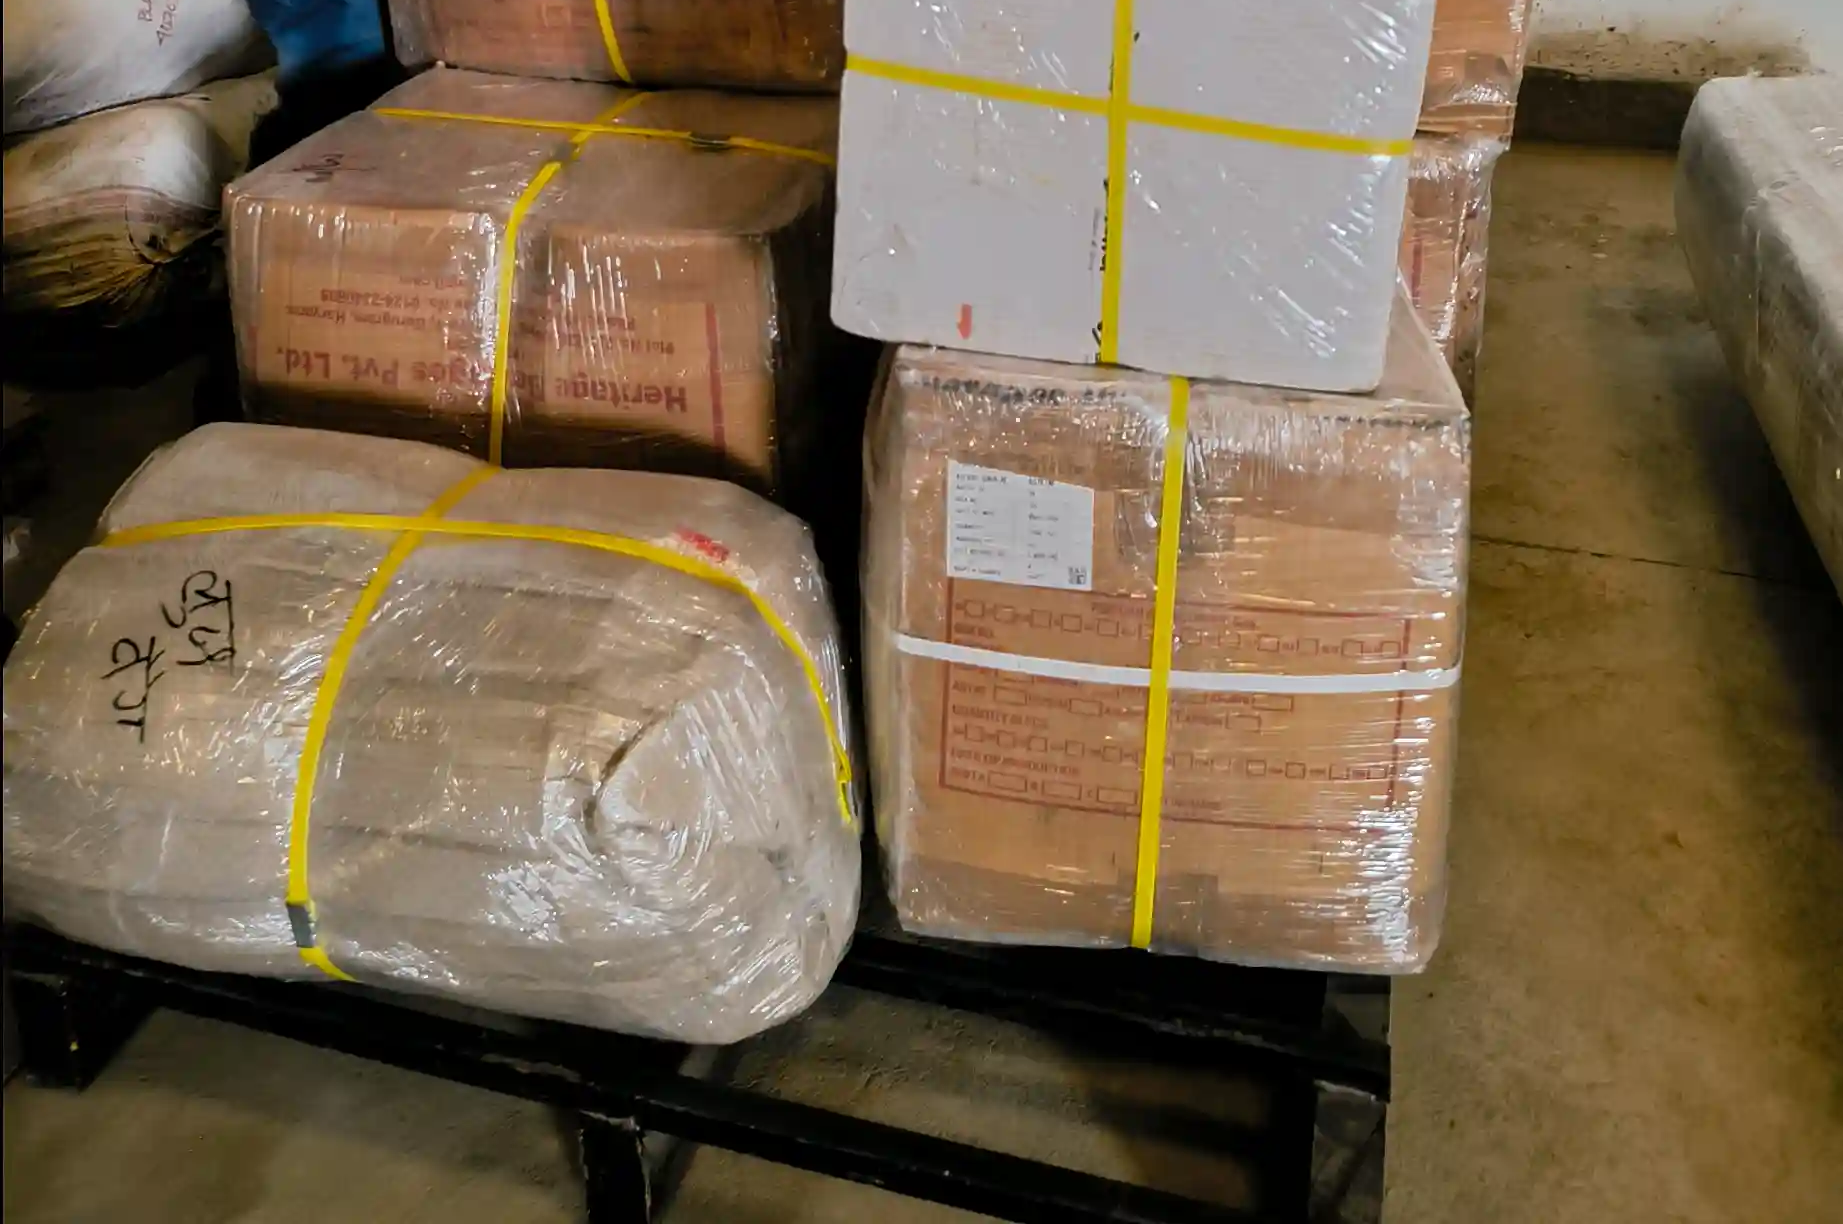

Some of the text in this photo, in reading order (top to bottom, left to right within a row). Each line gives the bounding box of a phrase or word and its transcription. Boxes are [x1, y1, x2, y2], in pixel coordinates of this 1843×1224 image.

[275, 346, 331, 379] Ltd.
[342, 354, 400, 389] Pvt.
[553, 372, 688, 415] Heritage
